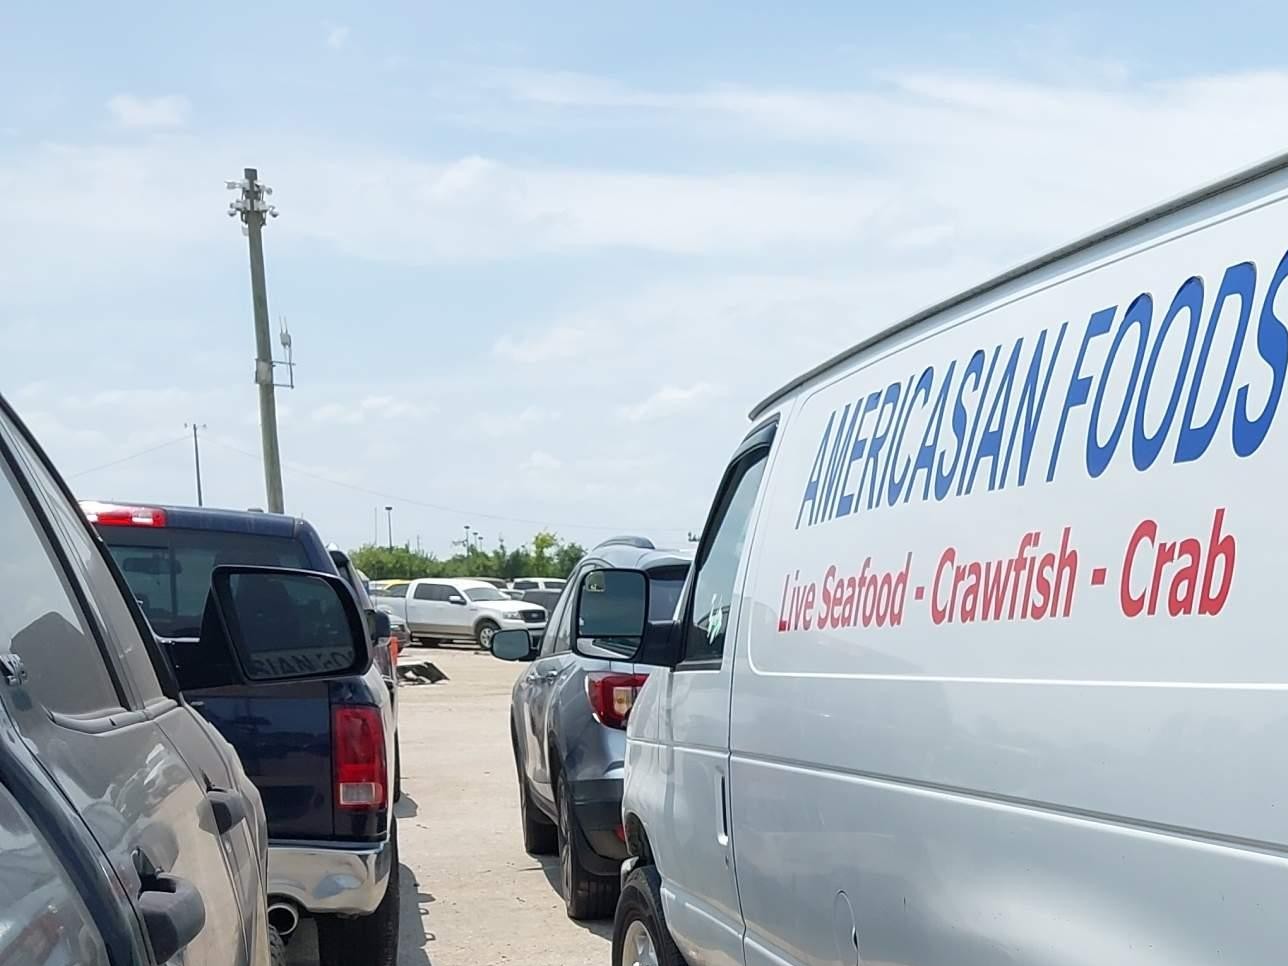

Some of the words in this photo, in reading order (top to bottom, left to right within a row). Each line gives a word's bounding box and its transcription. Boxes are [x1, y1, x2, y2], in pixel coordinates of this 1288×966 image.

[796, 321, 1068, 530] AMERICASIAN
[778, 572, 815, 632] Live
[817, 551, 913, 630] Seafood
[930, 526, 1078, 625] Crawfish
[1119, 507, 1237, 618] Crab
